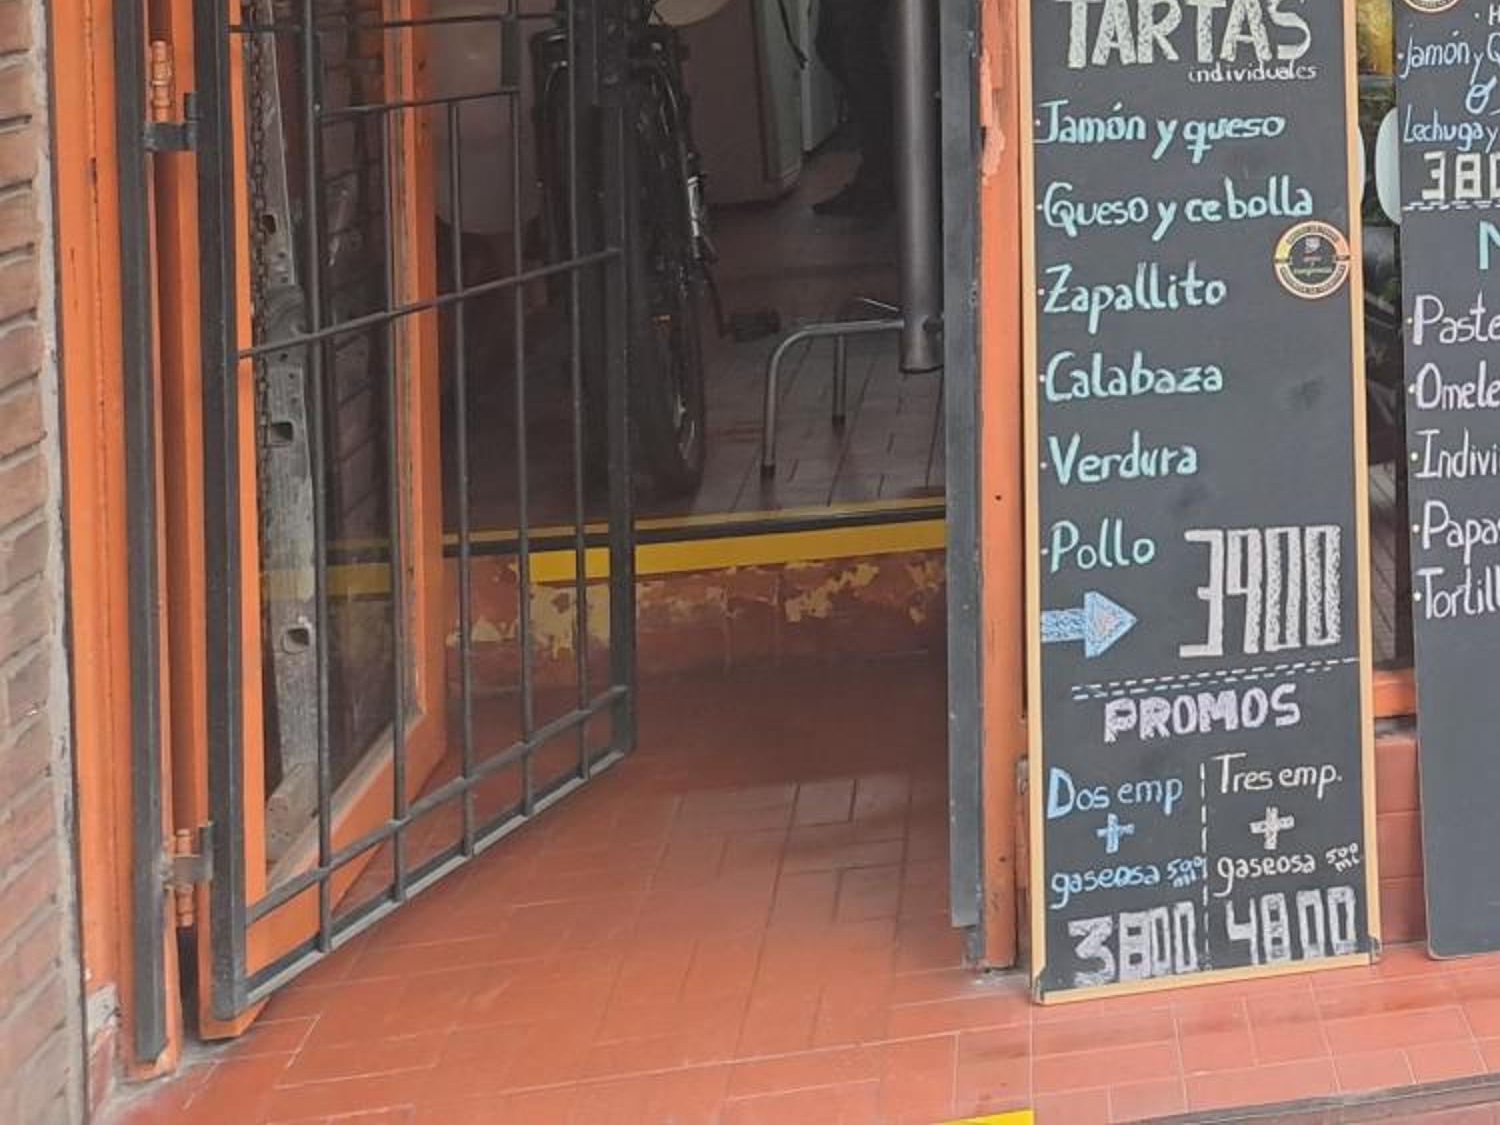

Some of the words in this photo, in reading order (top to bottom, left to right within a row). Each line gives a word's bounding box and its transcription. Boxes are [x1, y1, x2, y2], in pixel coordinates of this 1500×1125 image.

[1187, 58, 1318, 83] individuales
[1033, 99, 1147, 144] Jamón
[1152, 118, 1178, 161] y
[1183, 116, 1287, 164] queso
[1157, 199, 1177, 242] y
[1184, 176, 1313, 222] cebolla
[1043, 260, 1227, 335] Zapallito
[1045, 350, 1224, 402] Calabaza
[1048, 430, 1198, 486] Verdura
[1050, 518, 1156, 572] Pollo
[1178, 525, 1342, 657] 3900
[1104, 683, 1301, 743] PROMOS
[1047, 767, 1110, 820] Dos
[1118, 778, 1184, 815] emp
[1212, 752, 1273, 794] Tres
[1279, 762, 1343, 801] emp.
[1051, 863, 1160, 910] gaseosa
[1213, 854, 1316, 897] gaseosa
[1068, 901, 1199, 988] 3800
[1225, 886, 1358, 967] 4800
